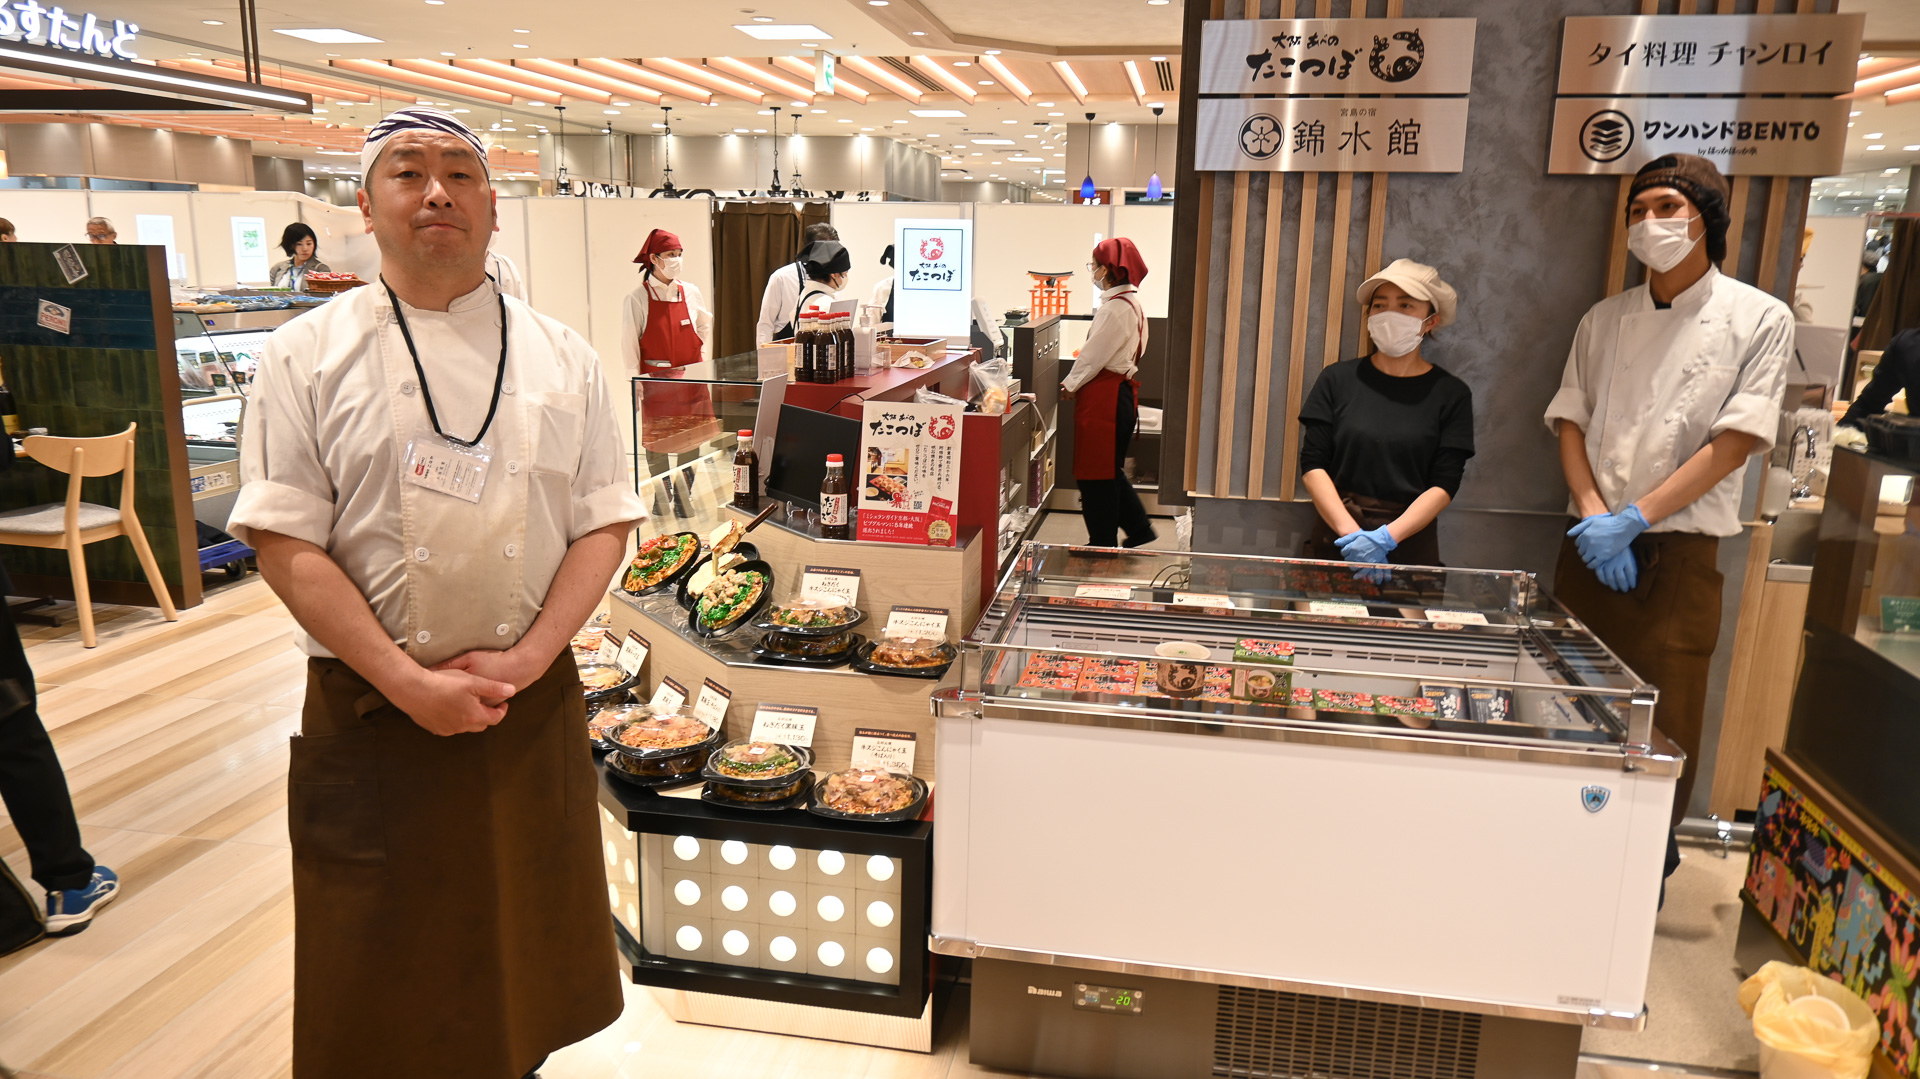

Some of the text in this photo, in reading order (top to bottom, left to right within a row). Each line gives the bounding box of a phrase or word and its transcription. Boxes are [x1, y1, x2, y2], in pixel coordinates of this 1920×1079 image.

[1272, 31, 1339, 49] 大阪 あべの
[1588, 41, 1833, 67] タイ料理 チャンロイ
[1246, 48, 1363, 82] たこつぼ
[1340, 108, 1376, 117] 宮島の宿
[1293, 118, 1421, 157] 錦水館
[1643, 121, 1820, 141] ワンハンドBENTO
[909, 269, 956, 282] たこつぼ
[882, 412, 897, 421] 大阪
[869, 420, 926, 437] たこつぼ
